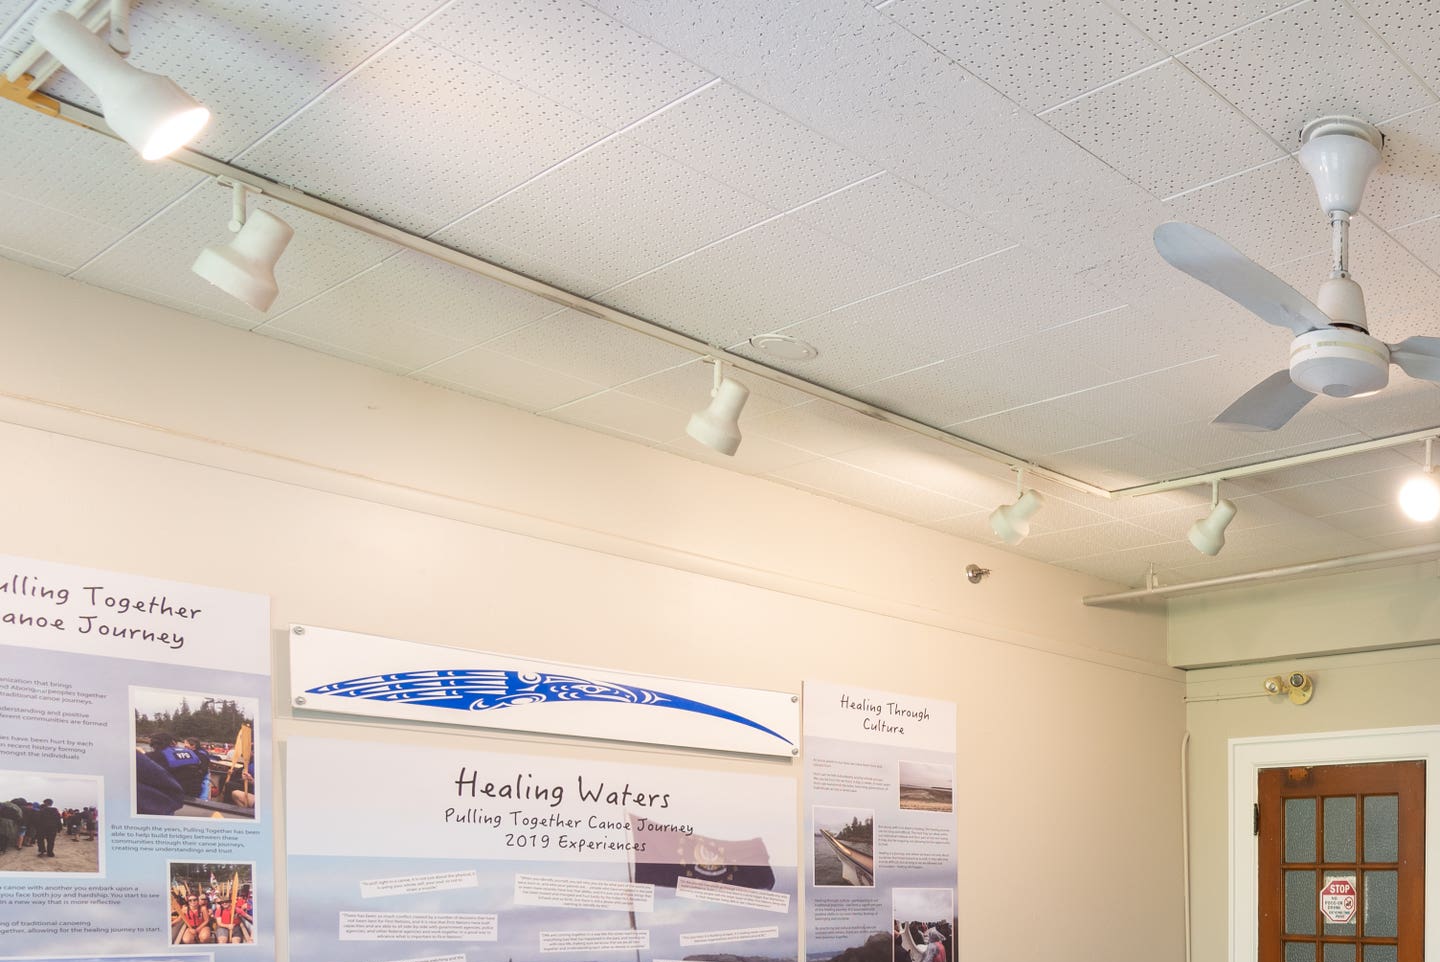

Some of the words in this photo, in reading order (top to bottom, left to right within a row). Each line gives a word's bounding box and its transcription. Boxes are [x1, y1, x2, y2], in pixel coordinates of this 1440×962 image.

[83, 586, 202, 619] Together
[78, 615, 184, 649] Journey
[840, 694, 882, 717] Healing
[886, 702, 931, 722] Through
[863, 717, 905, 735] Culture
[455, 767, 564, 808] Healing
[578, 776, 671, 809] Waters
[444, 807, 502, 829] Pulling
[509, 810, 582, 831] Together
[587, 813, 632, 832] Canoe
[635, 817, 695, 836] Journey
[505, 833, 551, 850] 2019
[557, 834, 647, 854] Experiences
[1329, 884, 1351, 894] STOP
